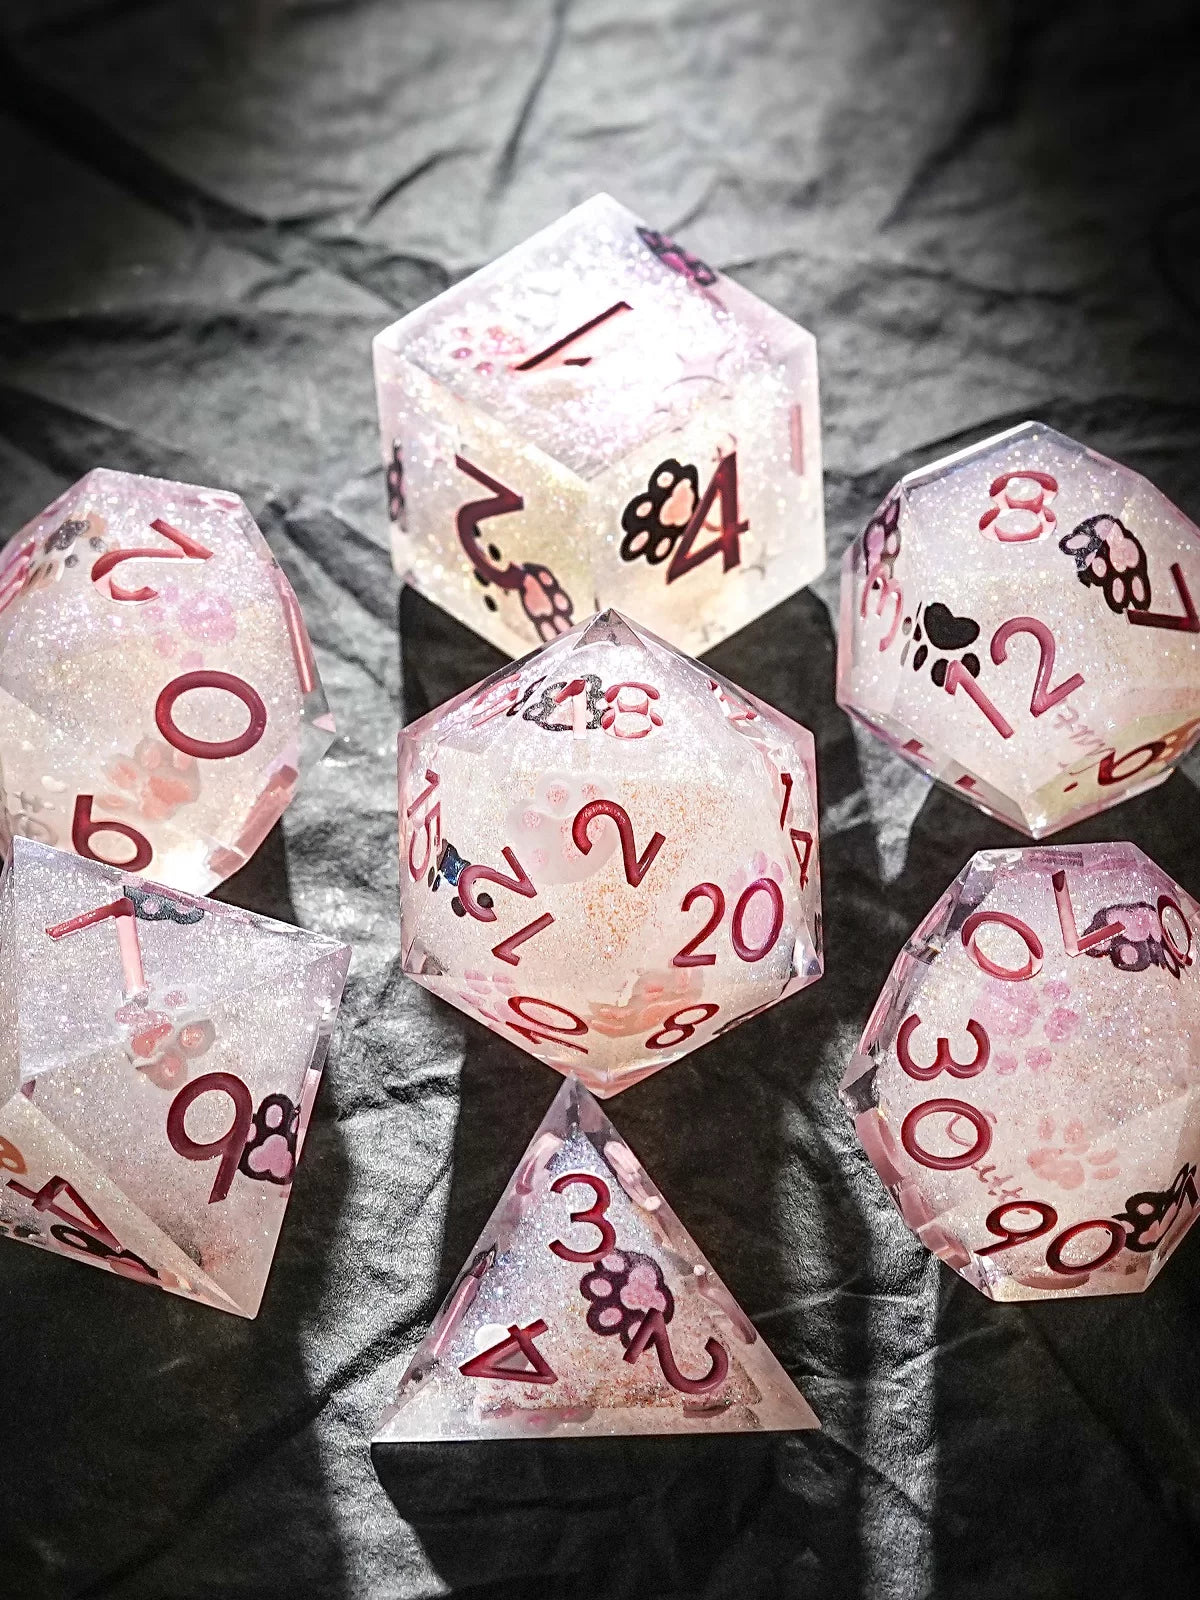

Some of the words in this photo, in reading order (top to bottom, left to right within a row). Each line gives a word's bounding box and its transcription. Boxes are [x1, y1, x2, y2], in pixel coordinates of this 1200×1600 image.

[455, 454, 525, 591] 2
[666, 451, 749, 586] 4
[979, 470, 1060, 544] 8
[91, 518, 213, 606] 2
[155, 670, 267, 760] 0
[944, 616, 1086, 740] 12
[572, 799, 666, 887] 2
[457, 846, 557, 967] 12
[672, 876, 785, 968] 20
[505, 995, 590, 1056] 10
[645, 1003, 721, 1050] 8
[548, 1172, 617, 1263] 3
[459, 1318, 559, 1385] 4
[622, 1308, 729, 1395] 2
